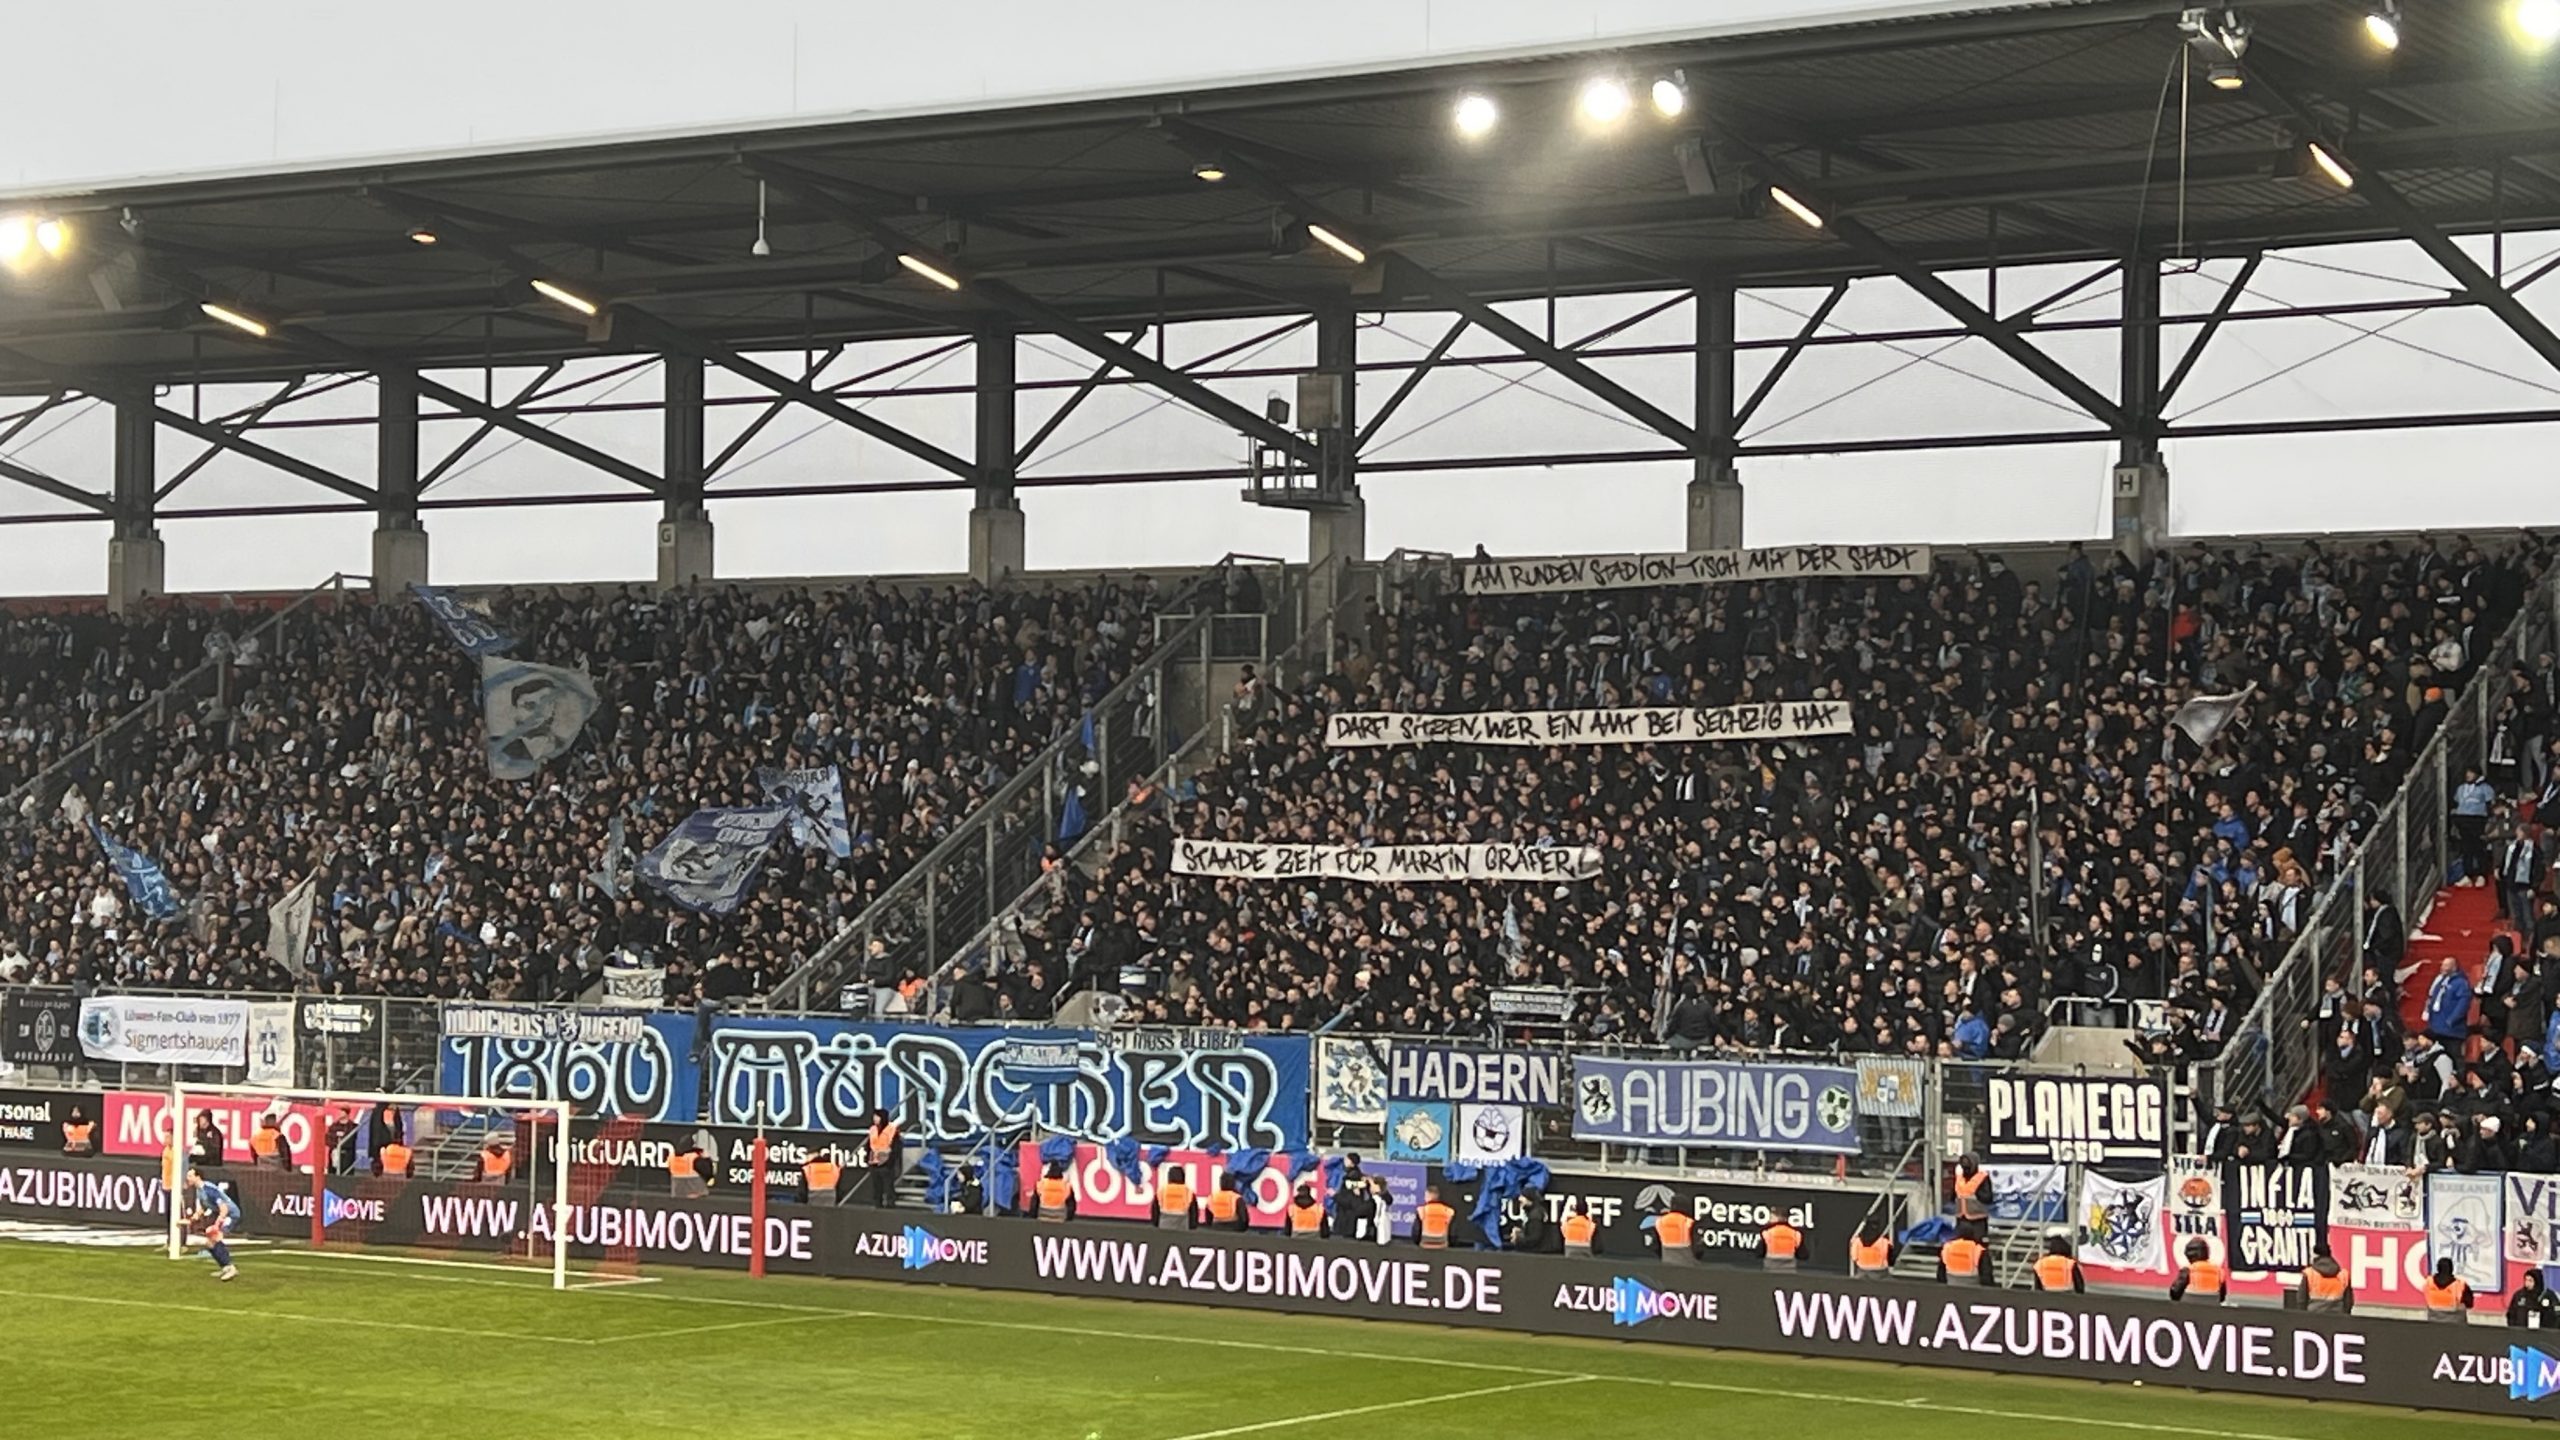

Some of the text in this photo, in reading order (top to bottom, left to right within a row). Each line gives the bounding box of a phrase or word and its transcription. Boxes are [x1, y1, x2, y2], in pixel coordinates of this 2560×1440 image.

[2119, 474, 2132, 491] H
[661, 527, 672, 543] G
[1471, 564, 1507, 590] AM
[1509, 559, 1586, 587] RUNDEN
[1796, 545, 1842, 571] DER
[1848, 546, 1918, 571] STADT
[1335, 715, 1389, 740] DARF
[1792, 703, 1840, 731] HAT
[1182, 842, 1268, 872] STAADE
[124, 1030, 239, 1052] Sigmertshausen
[451, 1025, 1285, 1153] 1860 MÜNCHEN
[1391, 1050, 1559, 1104] HADERN
[1622, 1069, 1811, 1139] AUBING
[1989, 1078, 2162, 1142] PLANEGG
[729, 1168, 802, 1186] SOFWARE
[2240, 1162, 2315, 1209] INFLA
[271, 1193, 385, 1222] AZUB MOVIE
[1694, 1196, 1814, 1228] Persoal
[422, 1194, 813, 1260] WWW.AZUBIMOVIEDE
[855, 1232, 988, 1264] AZUBI MOVIE
[1033, 1234, 1503, 1312] WWW.AZUBIMOVIE.DE
[1554, 1284, 1718, 1321] AZUBI MOVIE
[1774, 1289, 2366, 1384] WWW.AZUBIMOVIE.DE
[2433, 1353, 2524, 1385] AZUBI
